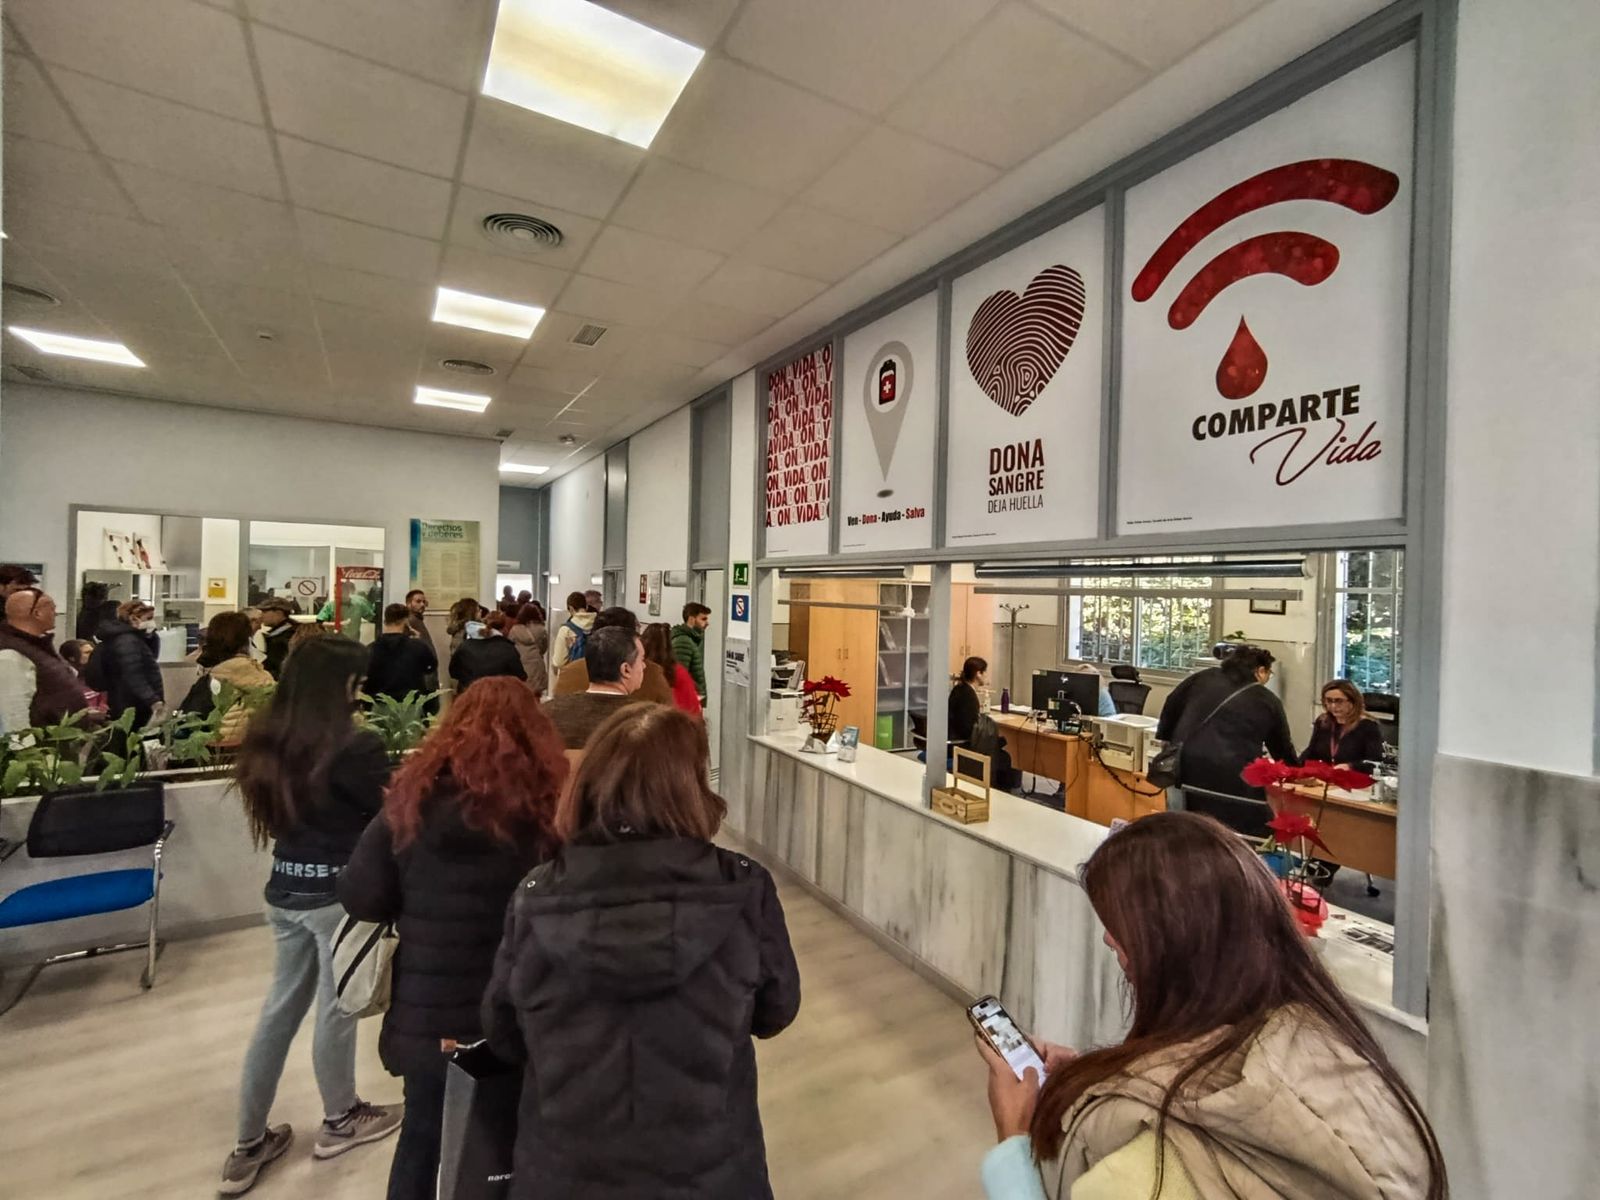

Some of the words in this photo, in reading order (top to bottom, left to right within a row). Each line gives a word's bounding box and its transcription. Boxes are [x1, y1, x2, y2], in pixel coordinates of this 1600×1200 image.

[793, 352, 816, 379] VIDA
[774, 381, 795, 404] VIDA
[793, 407, 816, 431] VIDA
[1192, 385, 1360, 440] COMPARTE
[804, 440, 829, 463] VIDA
[989, 438, 1044, 475] DONA
[1250, 418, 1381, 486] Vida
[784, 466, 805, 488] VIDA
[989, 469, 1044, 496] SANGRE
[766, 489, 787, 509] VIDA
[987, 499, 1007, 513] DEJA
[1009, 494, 1043, 511] HUELLA
[797, 502, 820, 524] VIDA
[847, 516, 858, 526] Ven
[862, 514, 877, 525] Dona
[881, 510, 901, 523] Ayuda
[906, 507, 925, 519] Salva
